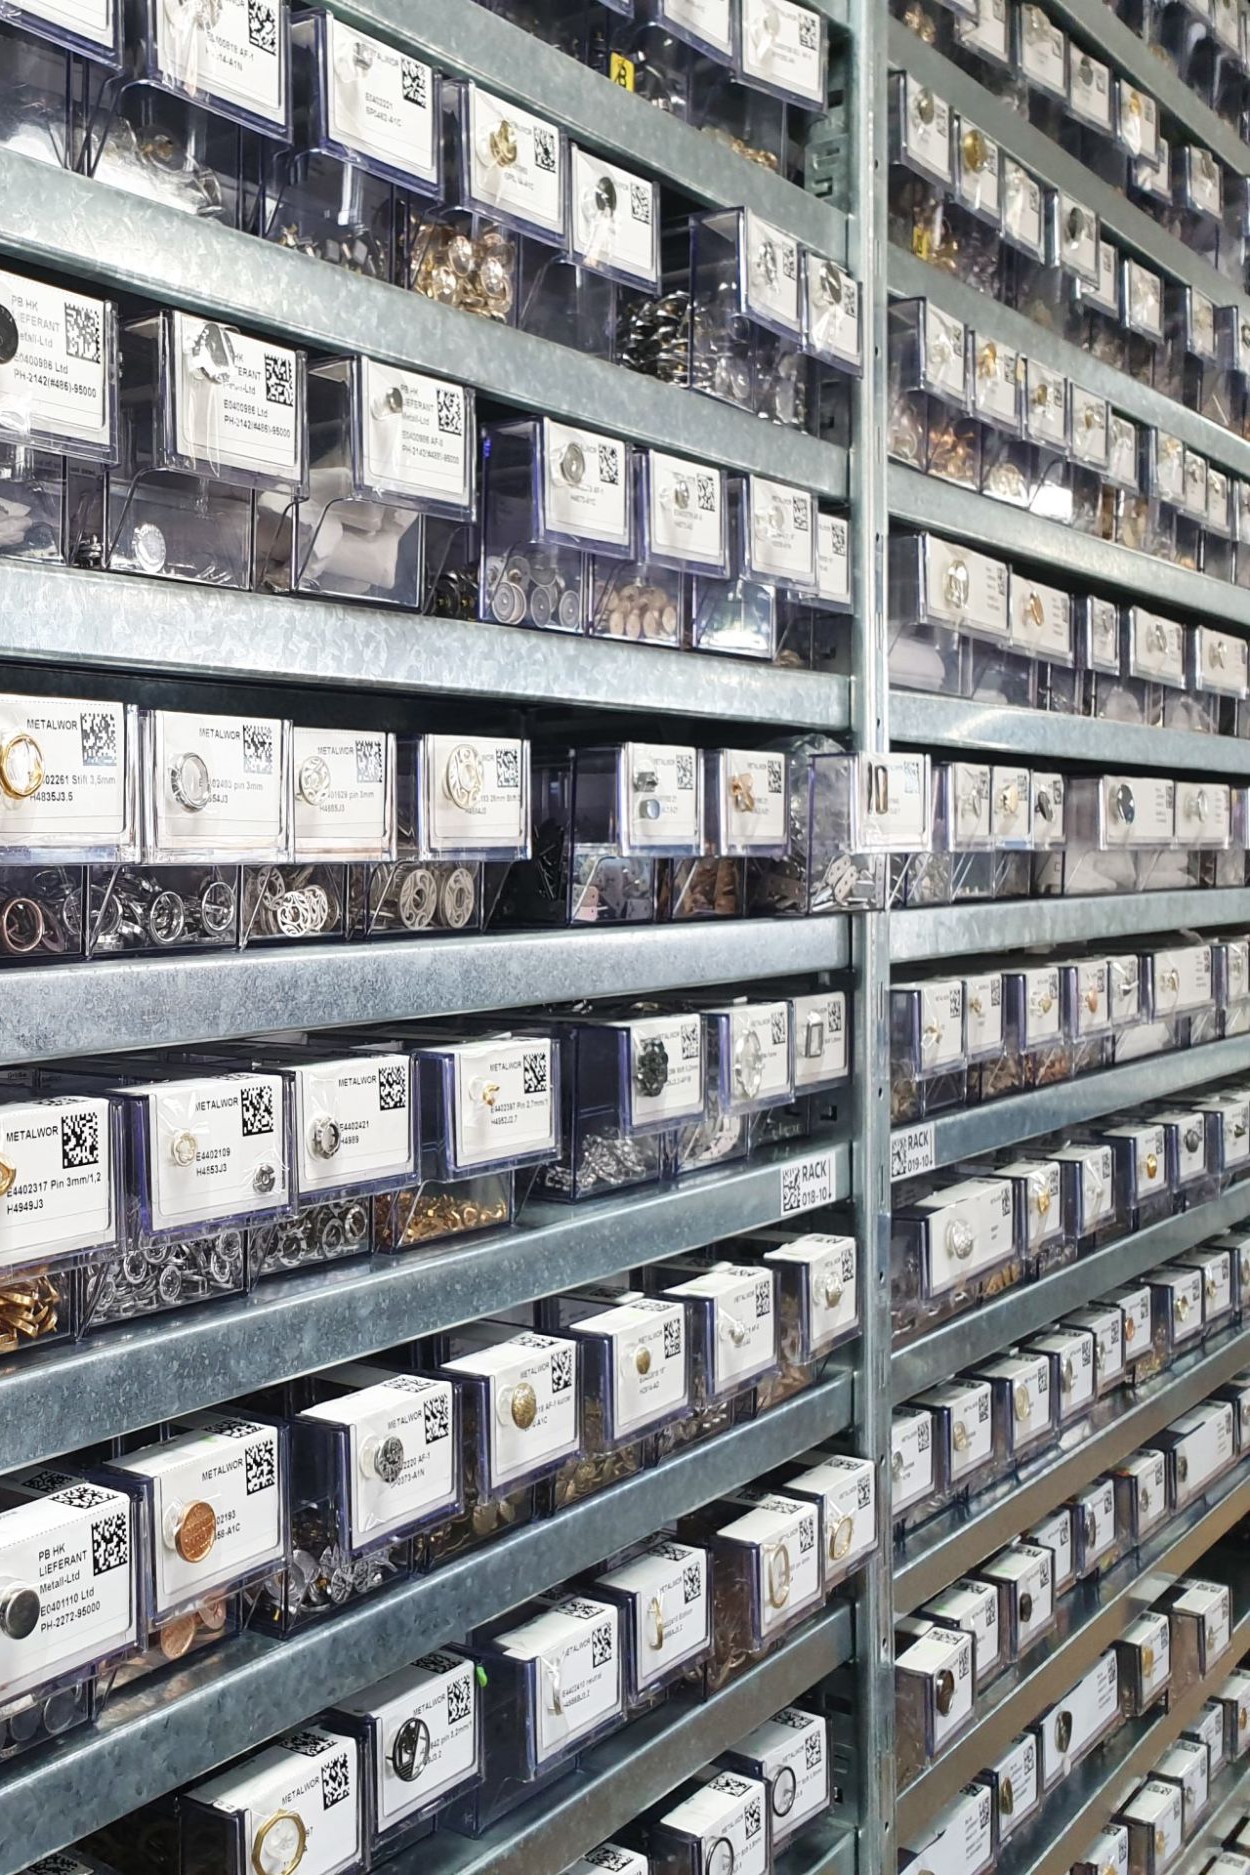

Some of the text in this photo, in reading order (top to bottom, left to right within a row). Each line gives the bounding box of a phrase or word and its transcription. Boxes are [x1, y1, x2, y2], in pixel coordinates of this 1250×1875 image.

[27, 719, 78, 730] METALWOR
[199, 728, 240, 740] METALWOR
[339, 1075, 376, 1087] METALWOR
[195, 1097, 239, 1111] METALWOR
[6, 1126, 59, 1142] METALWOR
[907, 1130, 929, 1150] RACK
[802, 1159, 827, 1182] RACK
[907, 1154, 929, 1172] 019-10
[7, 1181, 48, 1198] E4402317
[50, 1179, 64, 1190] Pin
[802, 1187, 827, 1206] 018-10
[7, 1199, 44, 1215] H4949J3
[202, 1458, 243, 1482] METALWOR
[39, 1543, 65, 1561] PB HK
[39, 1550, 87, 1577] LIEFERANT
[40, 1587, 94, 1617] E0401110 Ltd
[41, 1600, 100, 1633] PH-2272-95000
[282, 1776, 320, 1805] METALWOR
